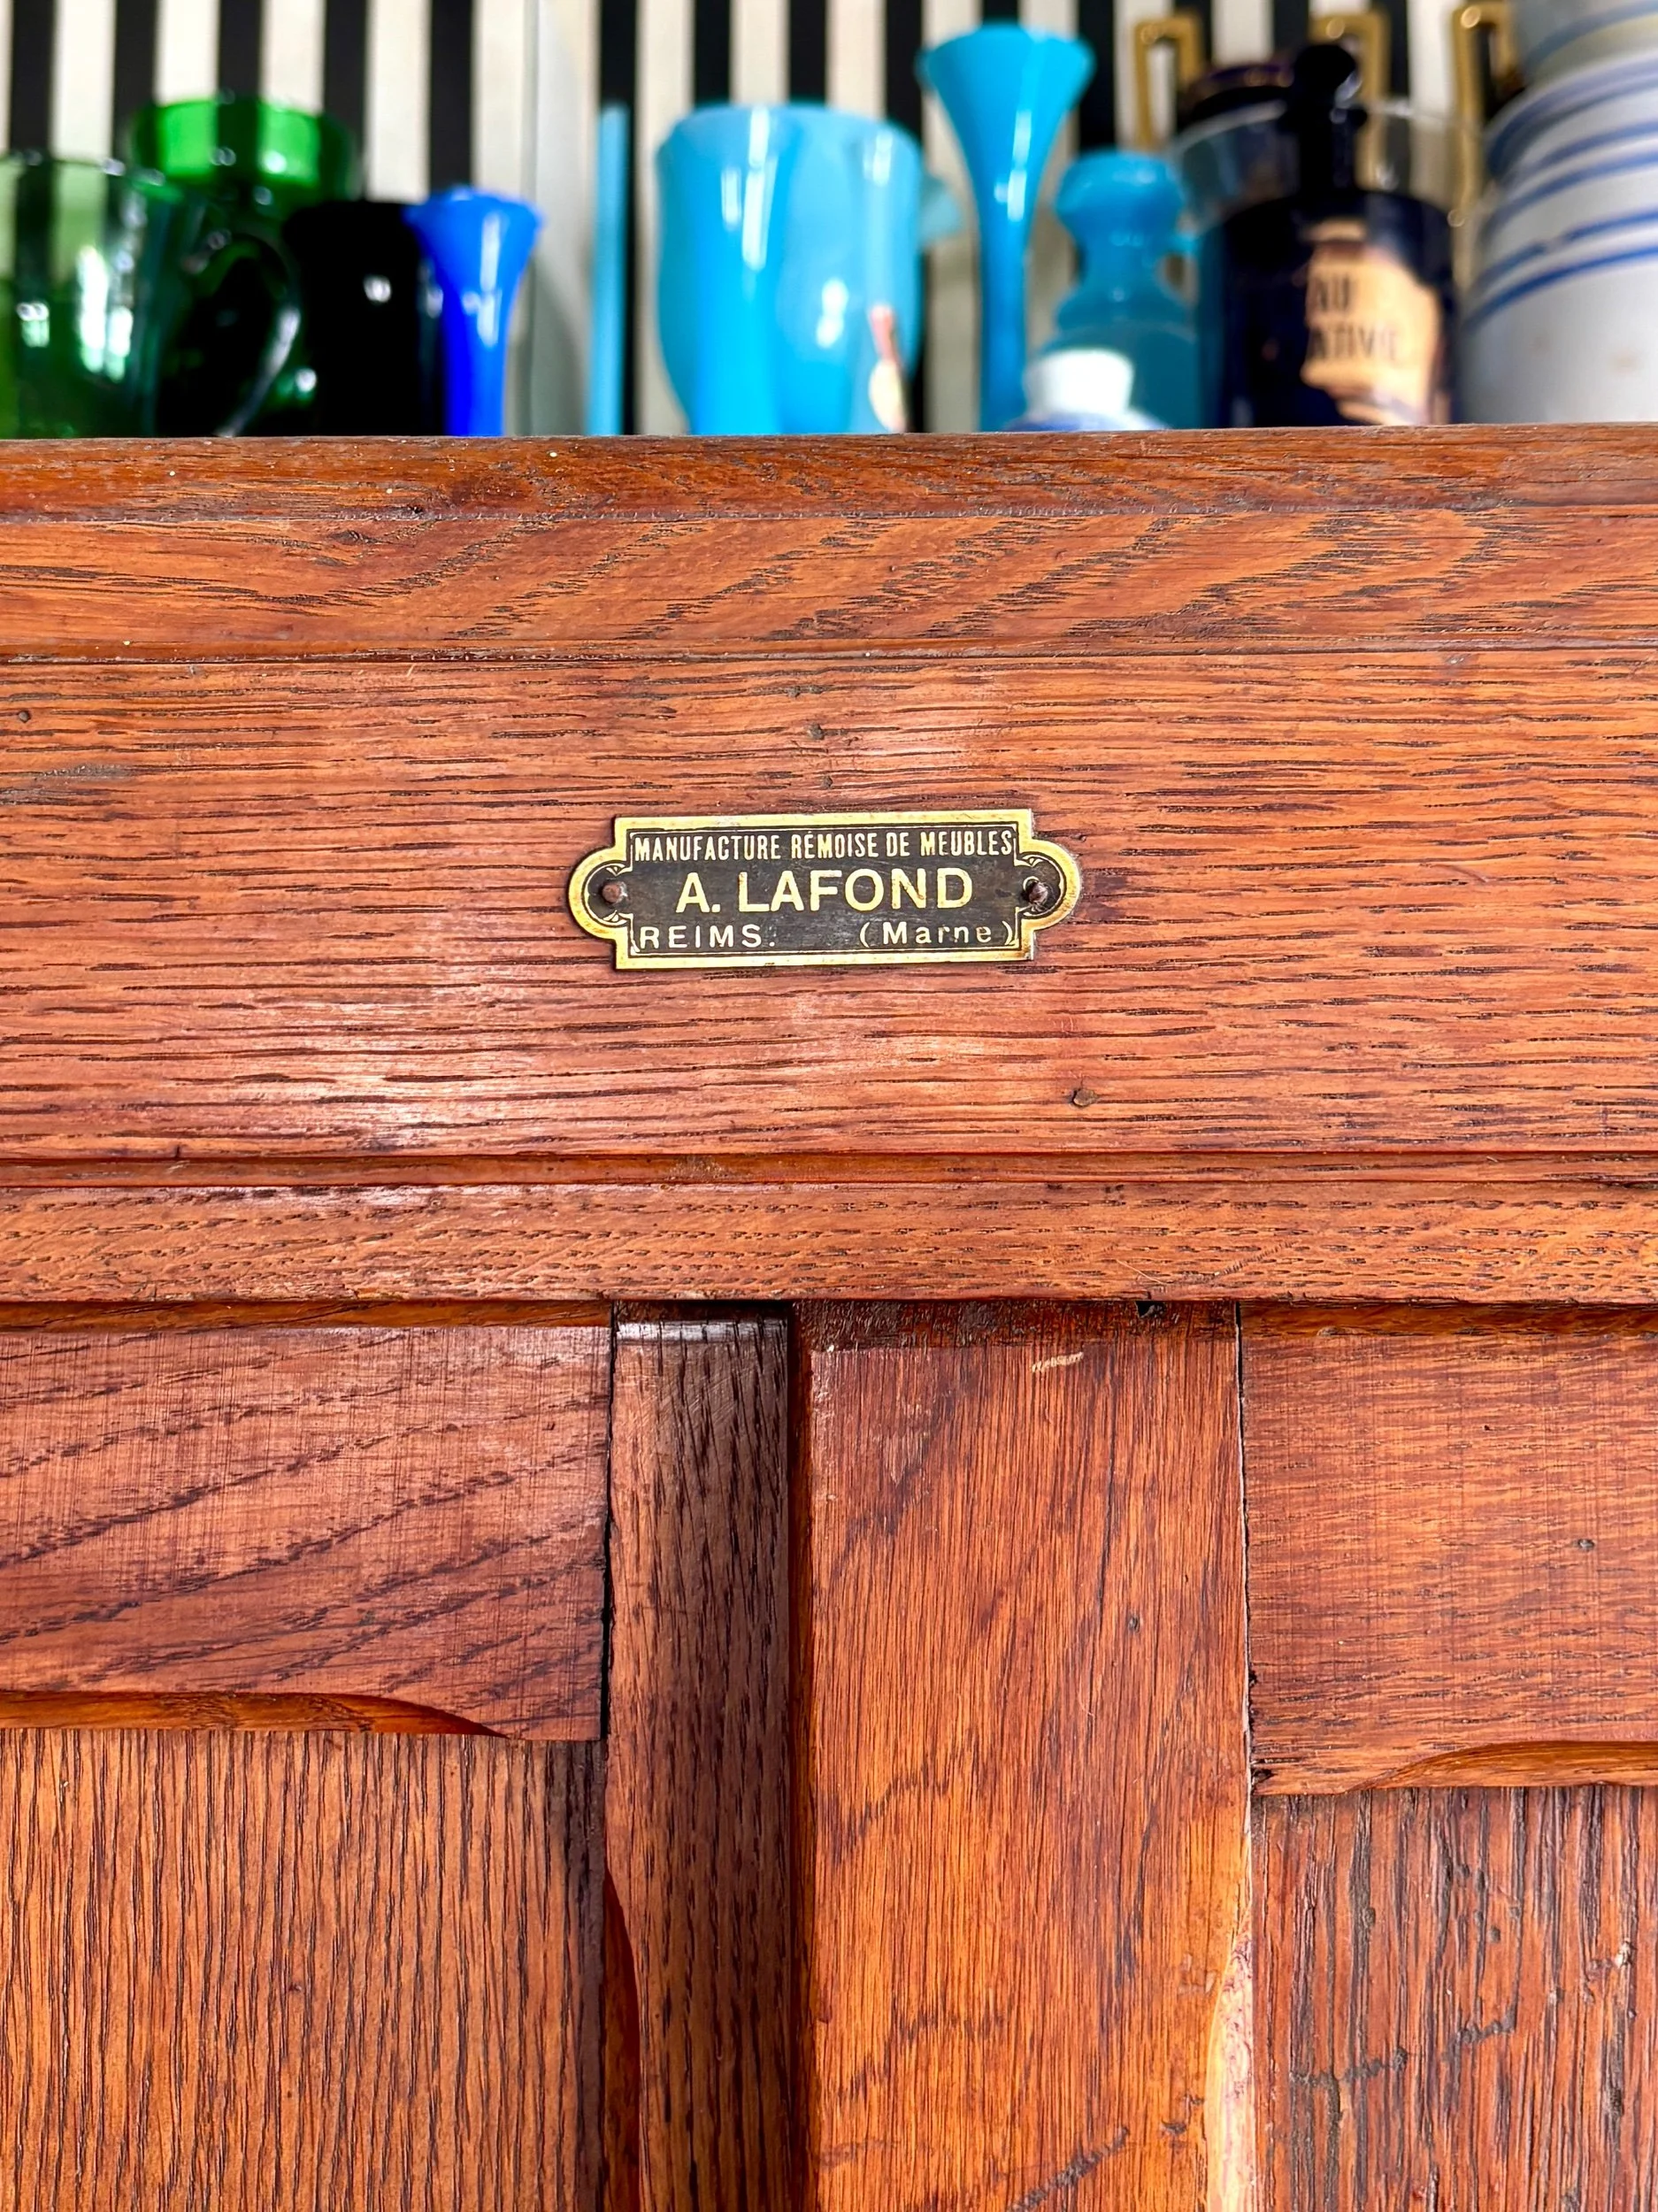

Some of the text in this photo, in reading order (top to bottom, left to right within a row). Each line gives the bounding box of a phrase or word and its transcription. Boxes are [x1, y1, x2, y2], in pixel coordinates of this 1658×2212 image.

[634, 830, 1012, 862] MANUFACTURE RÉMOISE DE MEUBLES
[676, 867, 972, 913] A. LAFOND
[640, 920, 1013, 949] REIMS. (Marne)
